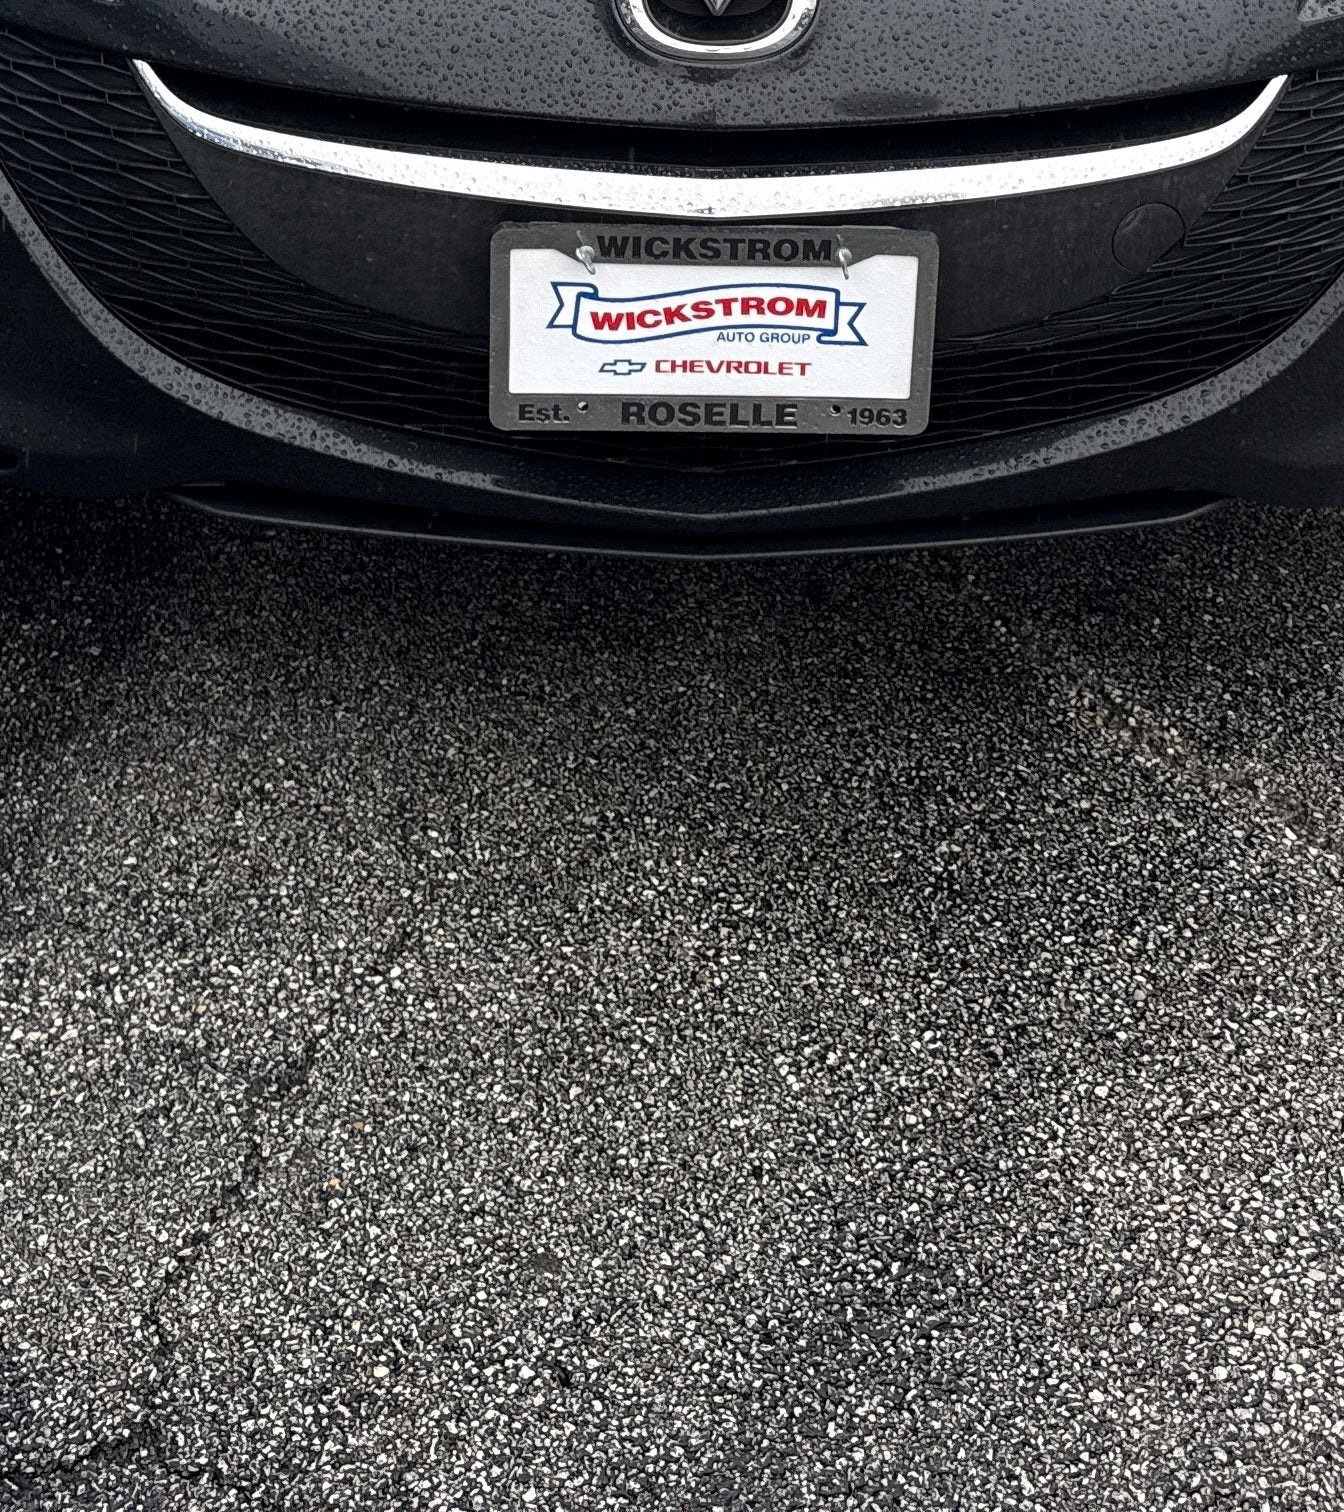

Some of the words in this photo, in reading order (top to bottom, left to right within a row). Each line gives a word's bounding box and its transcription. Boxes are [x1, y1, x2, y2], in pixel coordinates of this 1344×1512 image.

[596, 235, 832, 262] WICKSTROM
[590, 296, 827, 331] WICKSTROM
[716, 331, 755, 343] AUTO
[759, 331, 811, 344] GROUP
[654, 359, 812, 376] CHEVROLET
[518, 403, 570, 423] Est.
[621, 401, 798, 428] ROSELLE
[846, 407, 908, 427] 1963
